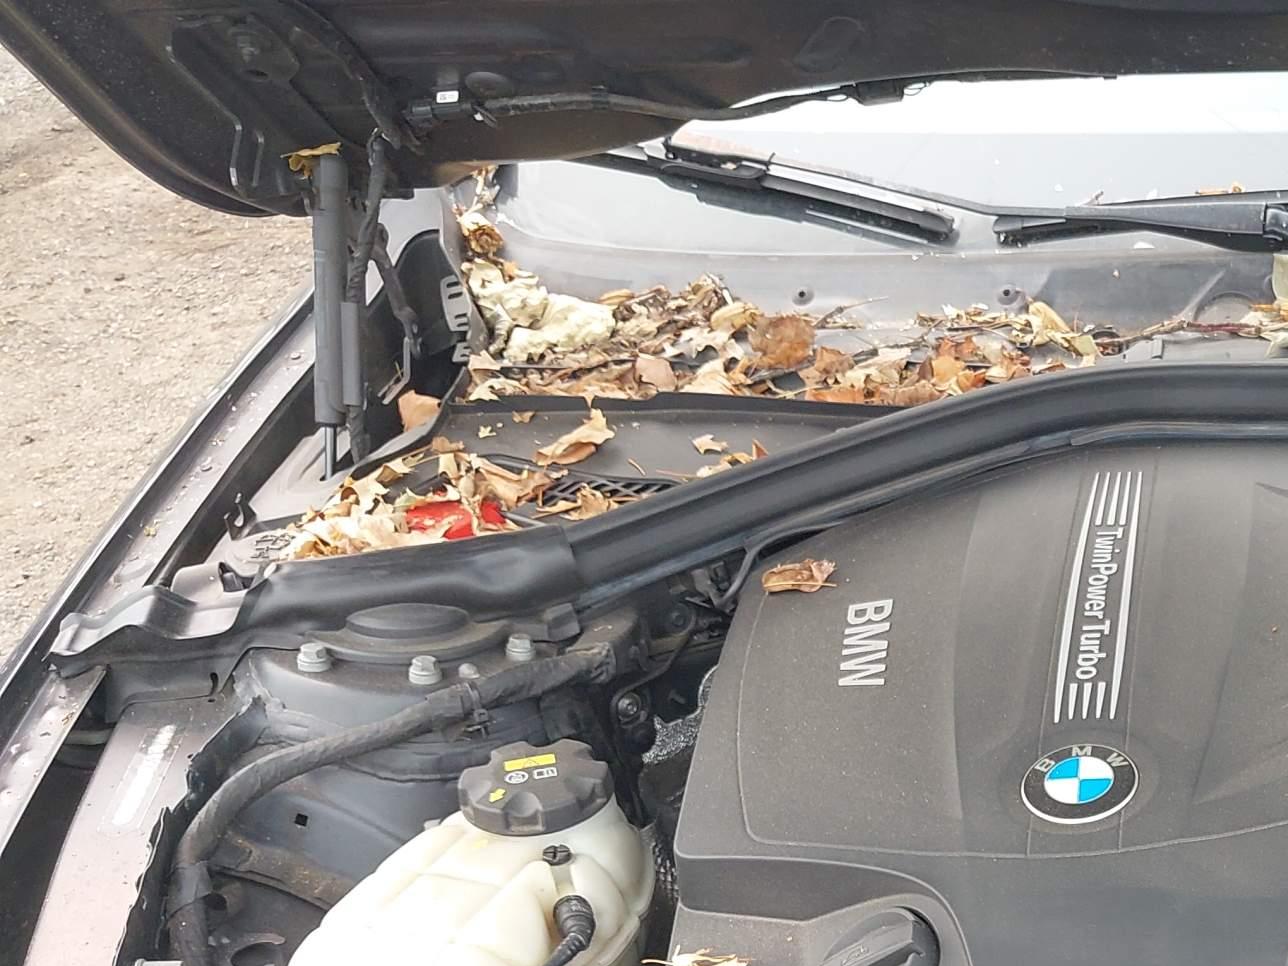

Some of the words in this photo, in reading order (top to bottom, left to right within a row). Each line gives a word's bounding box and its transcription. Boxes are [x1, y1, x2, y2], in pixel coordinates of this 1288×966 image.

[1083, 526, 1124, 619] TwinPower
[838, 598, 893, 686] BMW
[1075, 619, 1111, 680] Turbo
[1034, 745, 1129, 773] BMW
